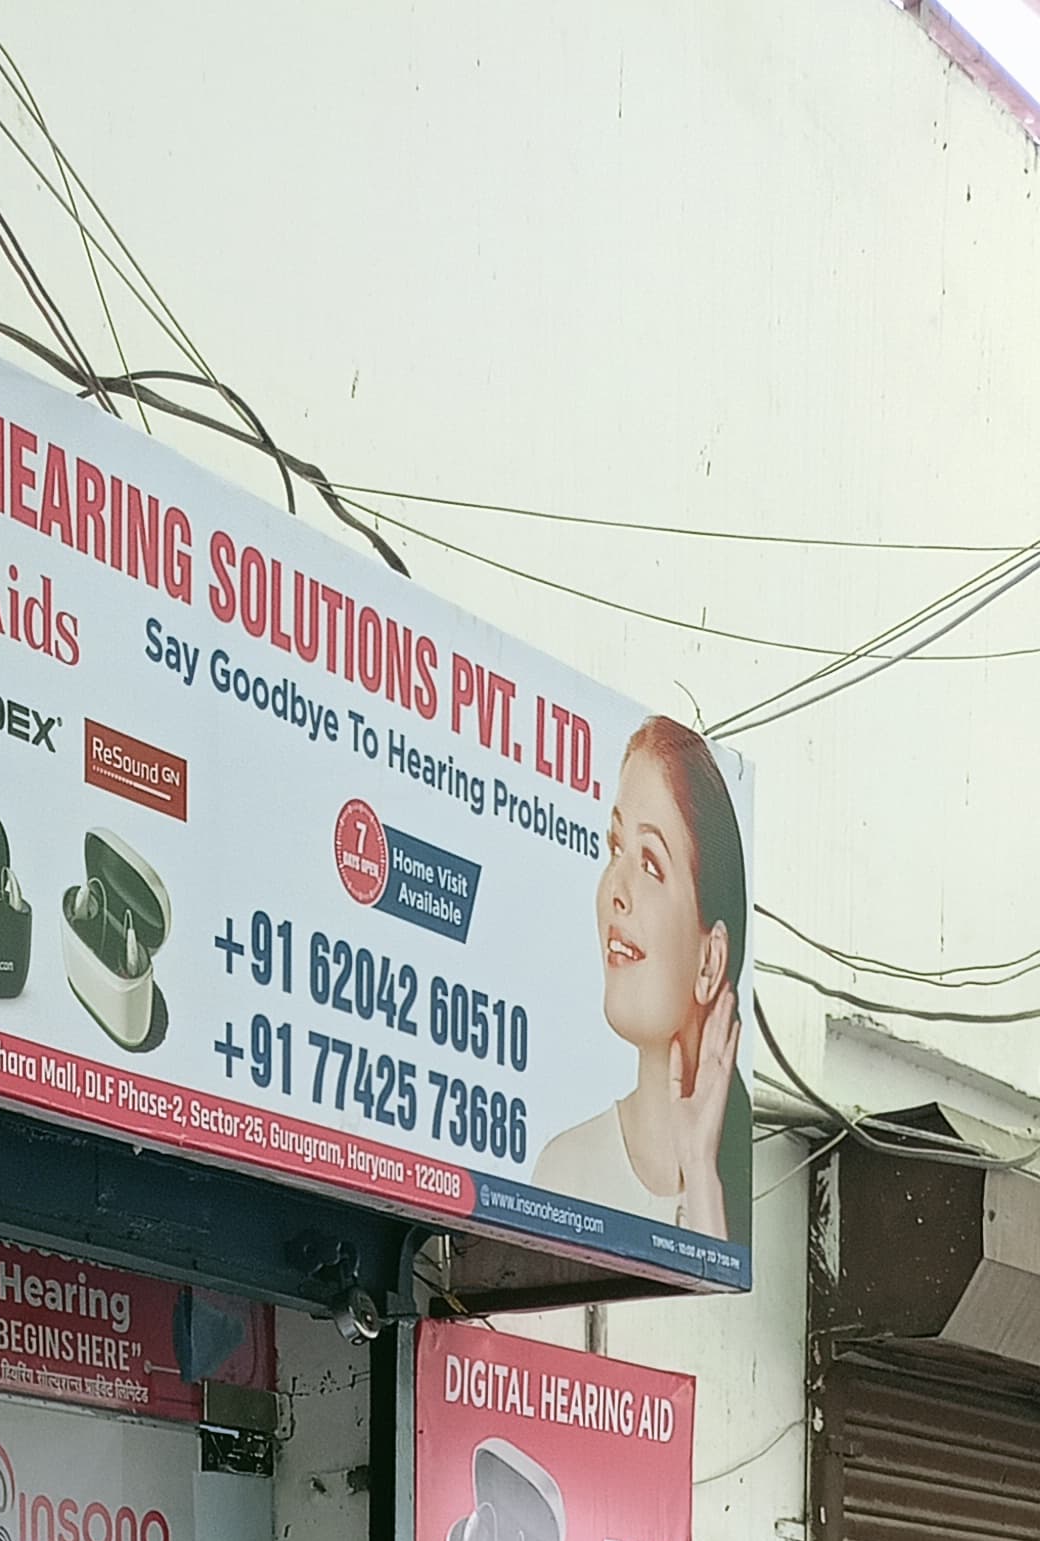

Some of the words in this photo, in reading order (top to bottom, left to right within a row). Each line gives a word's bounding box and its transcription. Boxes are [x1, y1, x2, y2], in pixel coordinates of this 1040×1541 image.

[208, 530, 440, 722] SOLUTIONS
[450, 651, 523, 764] PVT.
[533, 696, 602, 801] LTD.
[91, 736, 159, 787] ReSound
[160, 763, 181, 788] GN
[145, 616, 198, 686] Say
[210, 649, 339, 744] Goodbye
[347, 710, 379, 760] To
[388, 729, 486, 816] Hearing
[492, 793, 601, 861] Problems
[355, 820, 368, 855] 7
[392, 846, 435, 884] Home
[437, 864, 469, 899] Visit
[397, 882, 463, 926] Available
[214, 910, 293, 994] +91
[310, 931, 419, 1037] 62042
[430, 976, 528, 1073] 60510
[40, 1055, 81, 1099] Mall,
[84, 1070, 114, 1105] DLF
[117, 1080, 187, 1128] Phase-2,
[189, 1103, 268, 1149] Sector-25,
[270, 1124, 345, 1169] Gurugram,
[347, 1142, 404, 1184] Haryana
[414, 1163, 461, 1199] 122008
[214, 1013, 292, 1096] +91
[308, 1030, 417, 1132] 77425
[428, 1070, 528, 1164] 73686
[490, 1189, 605, 1235] www.insonohearing.com
[444, 1354, 536, 1418] DIGITAL
[539, 1374, 635, 1436] HEARING
[636, 1393, 675, 1443] AID
